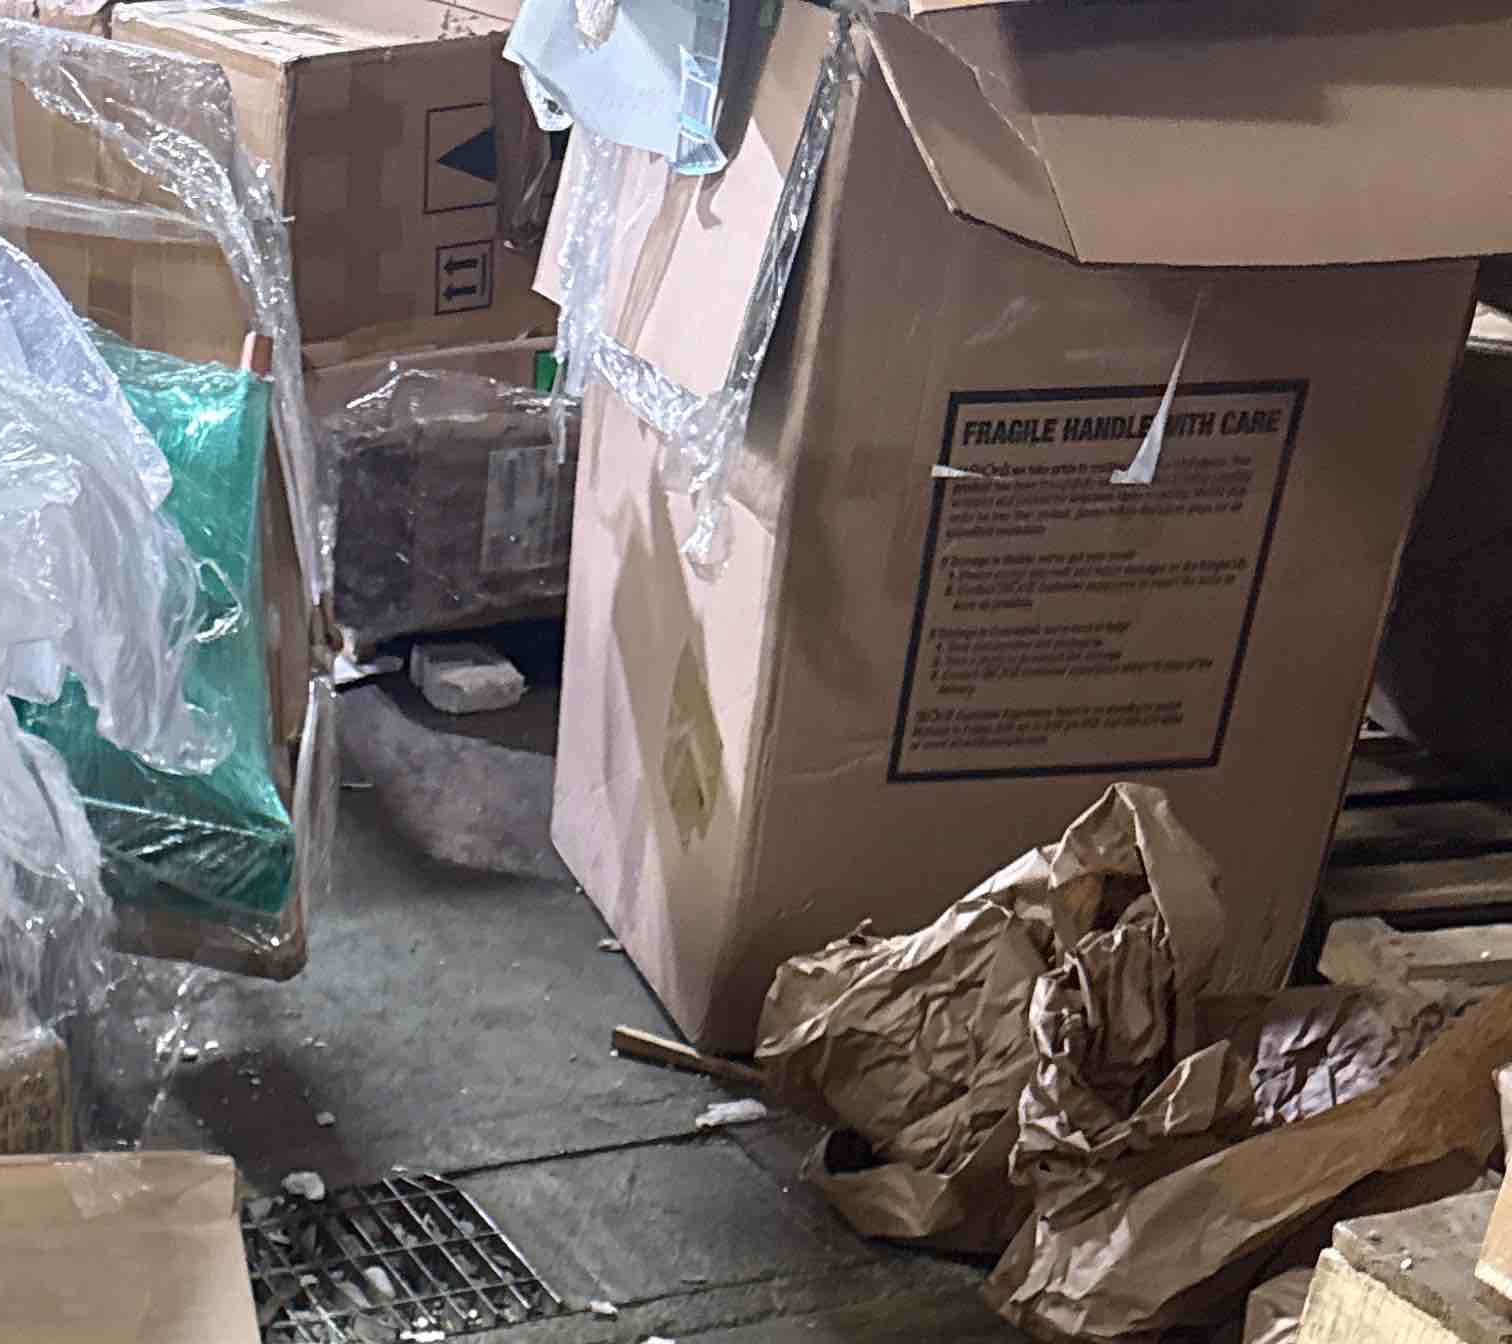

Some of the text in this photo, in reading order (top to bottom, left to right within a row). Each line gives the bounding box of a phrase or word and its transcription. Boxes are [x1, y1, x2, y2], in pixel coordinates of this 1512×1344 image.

[962, 417, 1057, 446] FRAGILE
[1063, 415, 1155, 441] HANDLE
[1219, 409, 1283, 435] CARE
